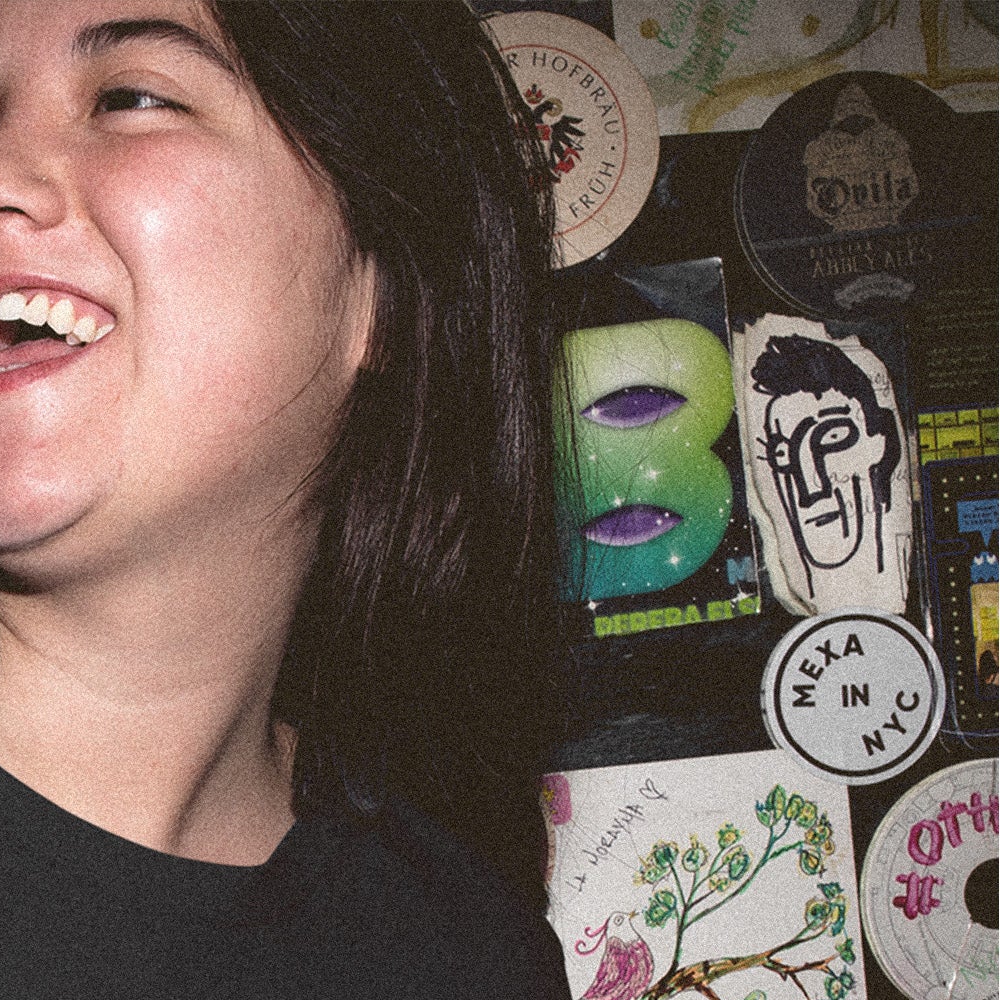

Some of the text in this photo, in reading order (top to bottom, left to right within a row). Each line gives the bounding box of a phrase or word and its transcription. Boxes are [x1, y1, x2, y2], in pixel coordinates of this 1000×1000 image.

[568, 161, 616, 218] FRÜH
[792, 633, 865, 708] MEXA
[841, 683, 869, 708] IN
[861, 690, 920, 757] NYC
